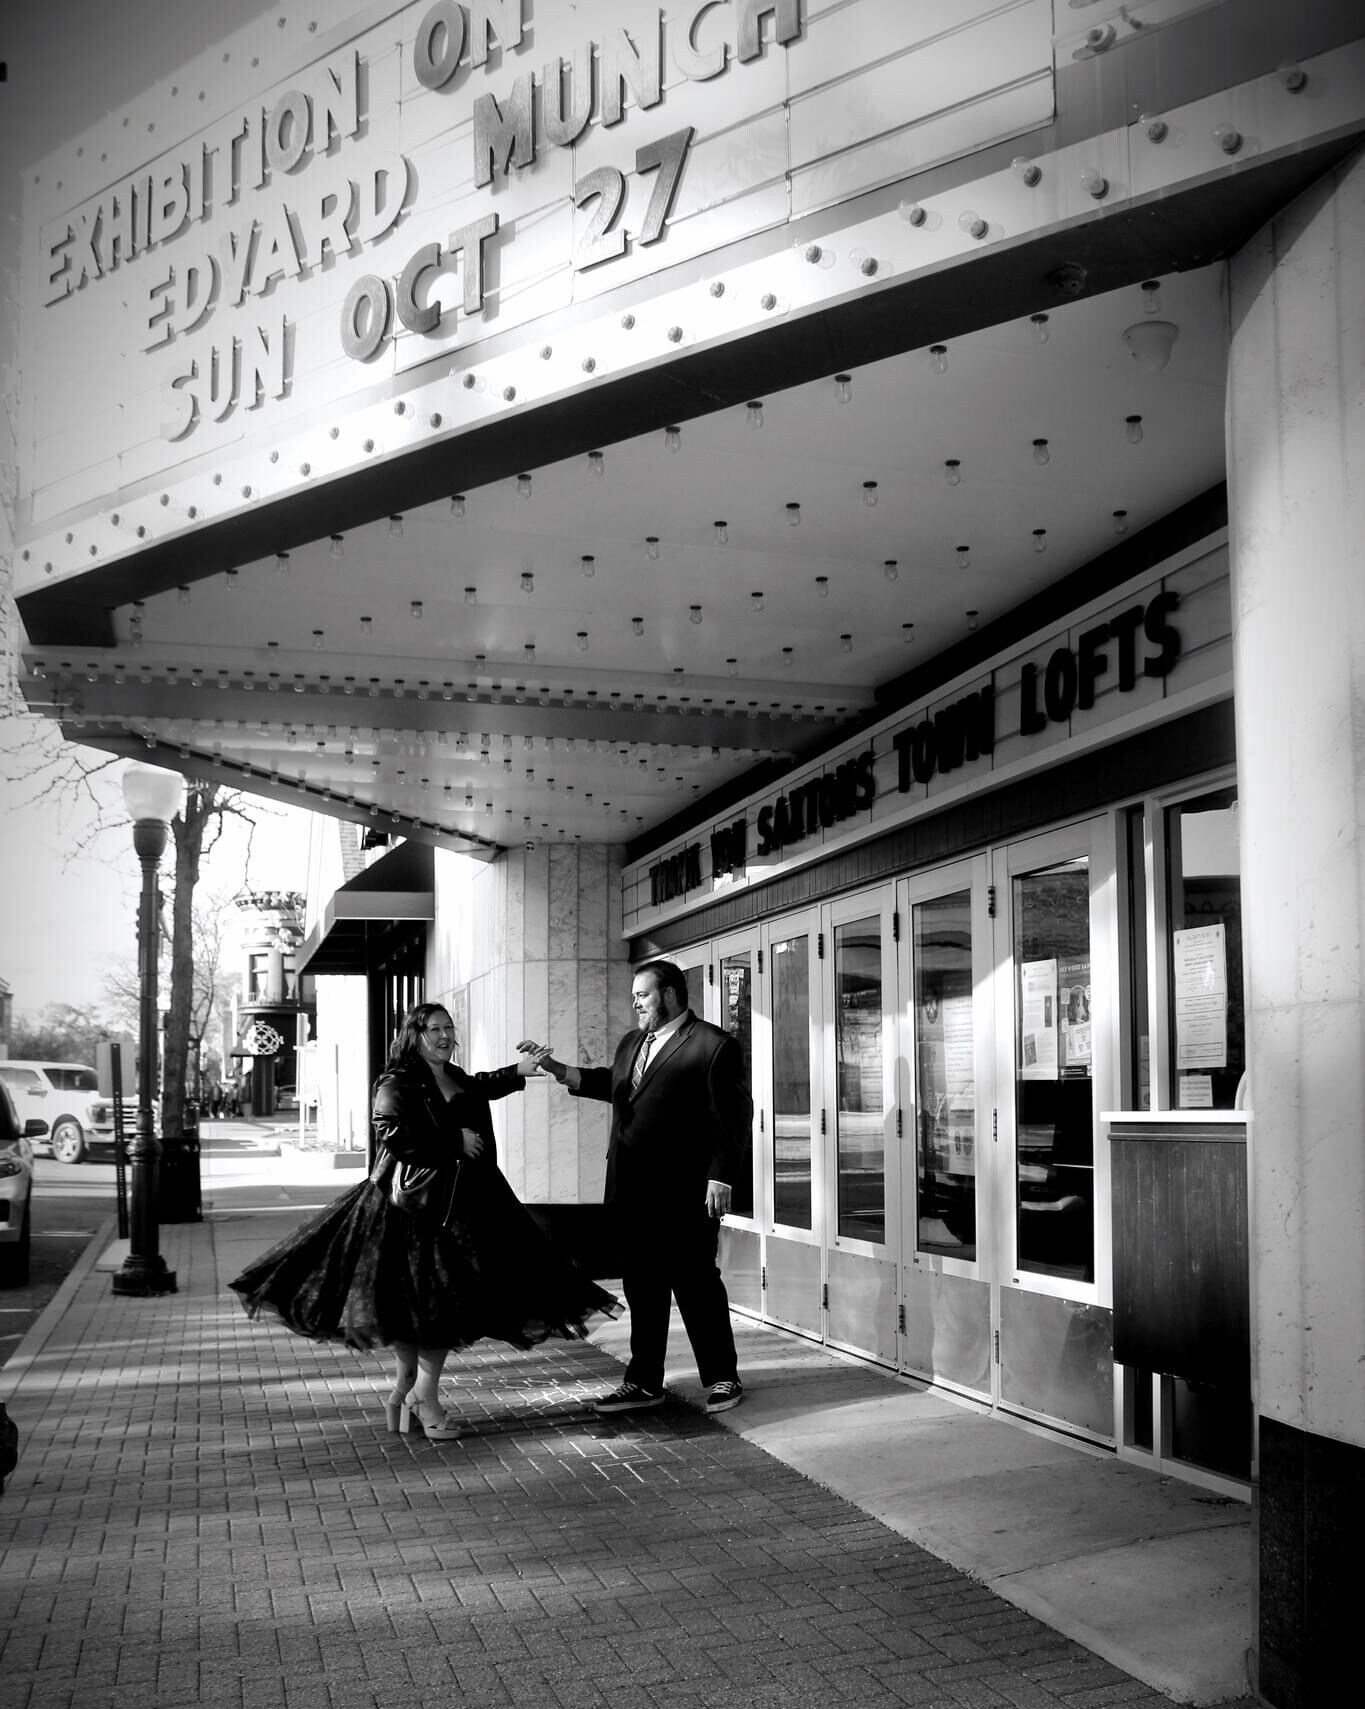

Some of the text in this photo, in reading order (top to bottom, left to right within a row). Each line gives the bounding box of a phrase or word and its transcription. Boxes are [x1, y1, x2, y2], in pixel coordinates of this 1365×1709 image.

[42, 0, 524, 307] EXHIBITION ON
[142, 0, 802, 353] EDVARD MUNCH
[161, 126, 695, 442] SUN OCT 27
[893, 685, 995, 793] TOWN
[1020, 591, 1181, 735] LOFTS
